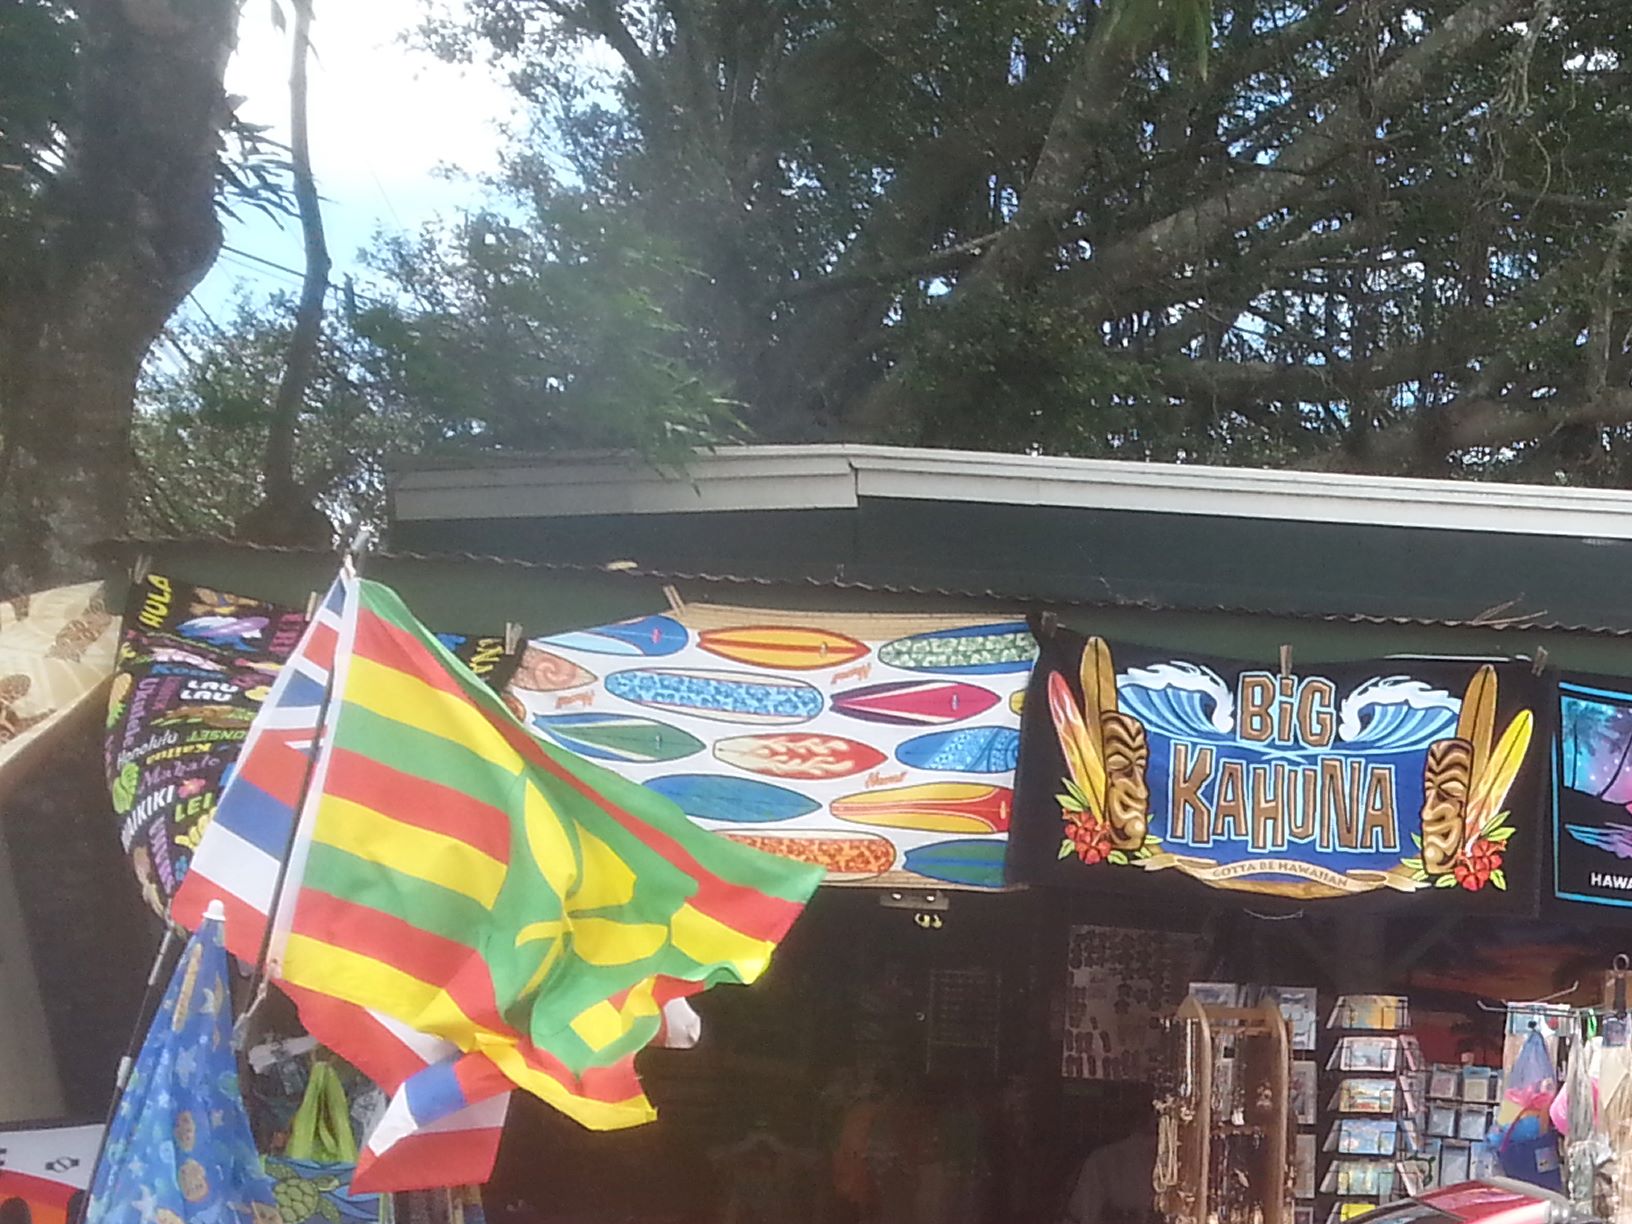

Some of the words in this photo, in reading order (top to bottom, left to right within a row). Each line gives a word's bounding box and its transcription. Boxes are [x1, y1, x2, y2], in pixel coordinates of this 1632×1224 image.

[138, 573, 173, 629] HULA
[175, 792, 213, 823] LEI
[1170, 741, 1399, 851] KAHUNA
[1212, 863, 1256, 878] GOTTA
[1259, 861, 1274, 871] BE
[1278, 862, 1349, 887] HAWAIIAN
